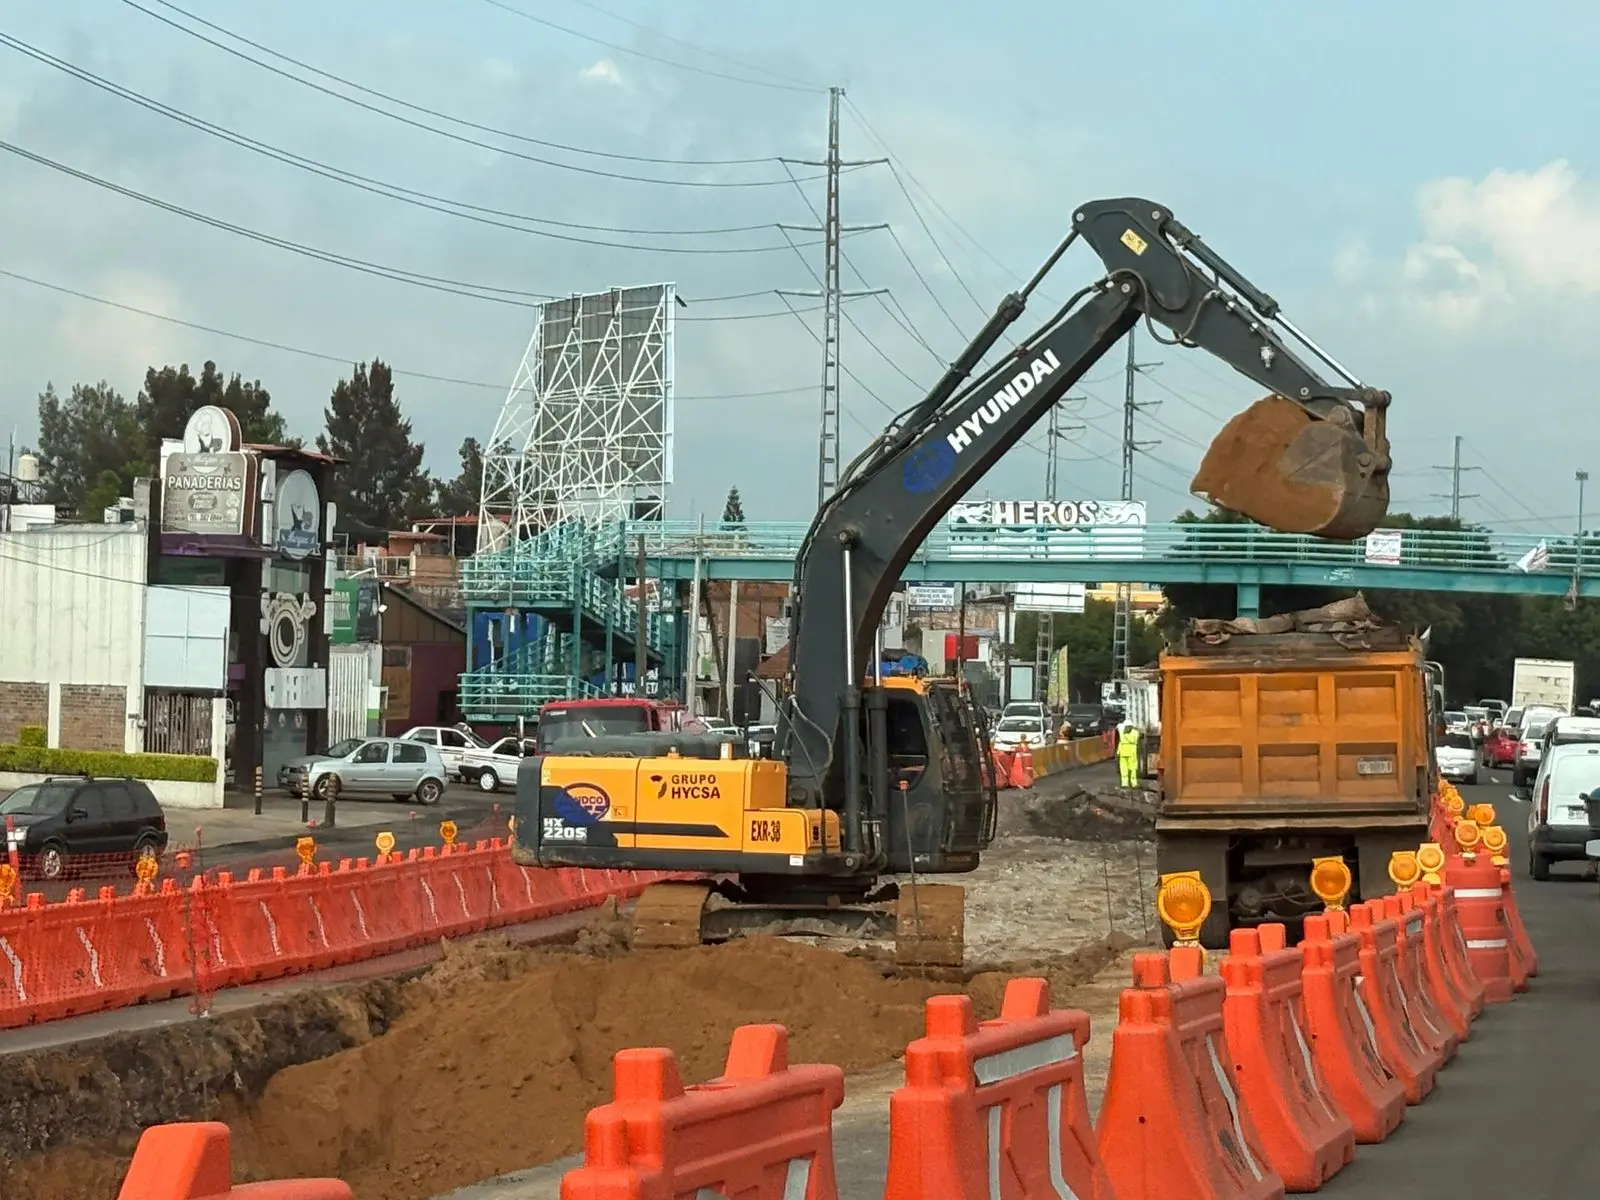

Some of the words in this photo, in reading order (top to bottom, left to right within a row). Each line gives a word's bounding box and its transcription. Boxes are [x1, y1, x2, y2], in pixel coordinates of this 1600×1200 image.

[946, 348, 1060, 454] HYUNDAI
[671, 774, 717, 785] GRUPO
[671, 786, 721, 799] HYCSA
[543, 817, 565, 827] HX
[543, 826, 588, 839] 220S
[751, 820, 781, 842] EXR-38
